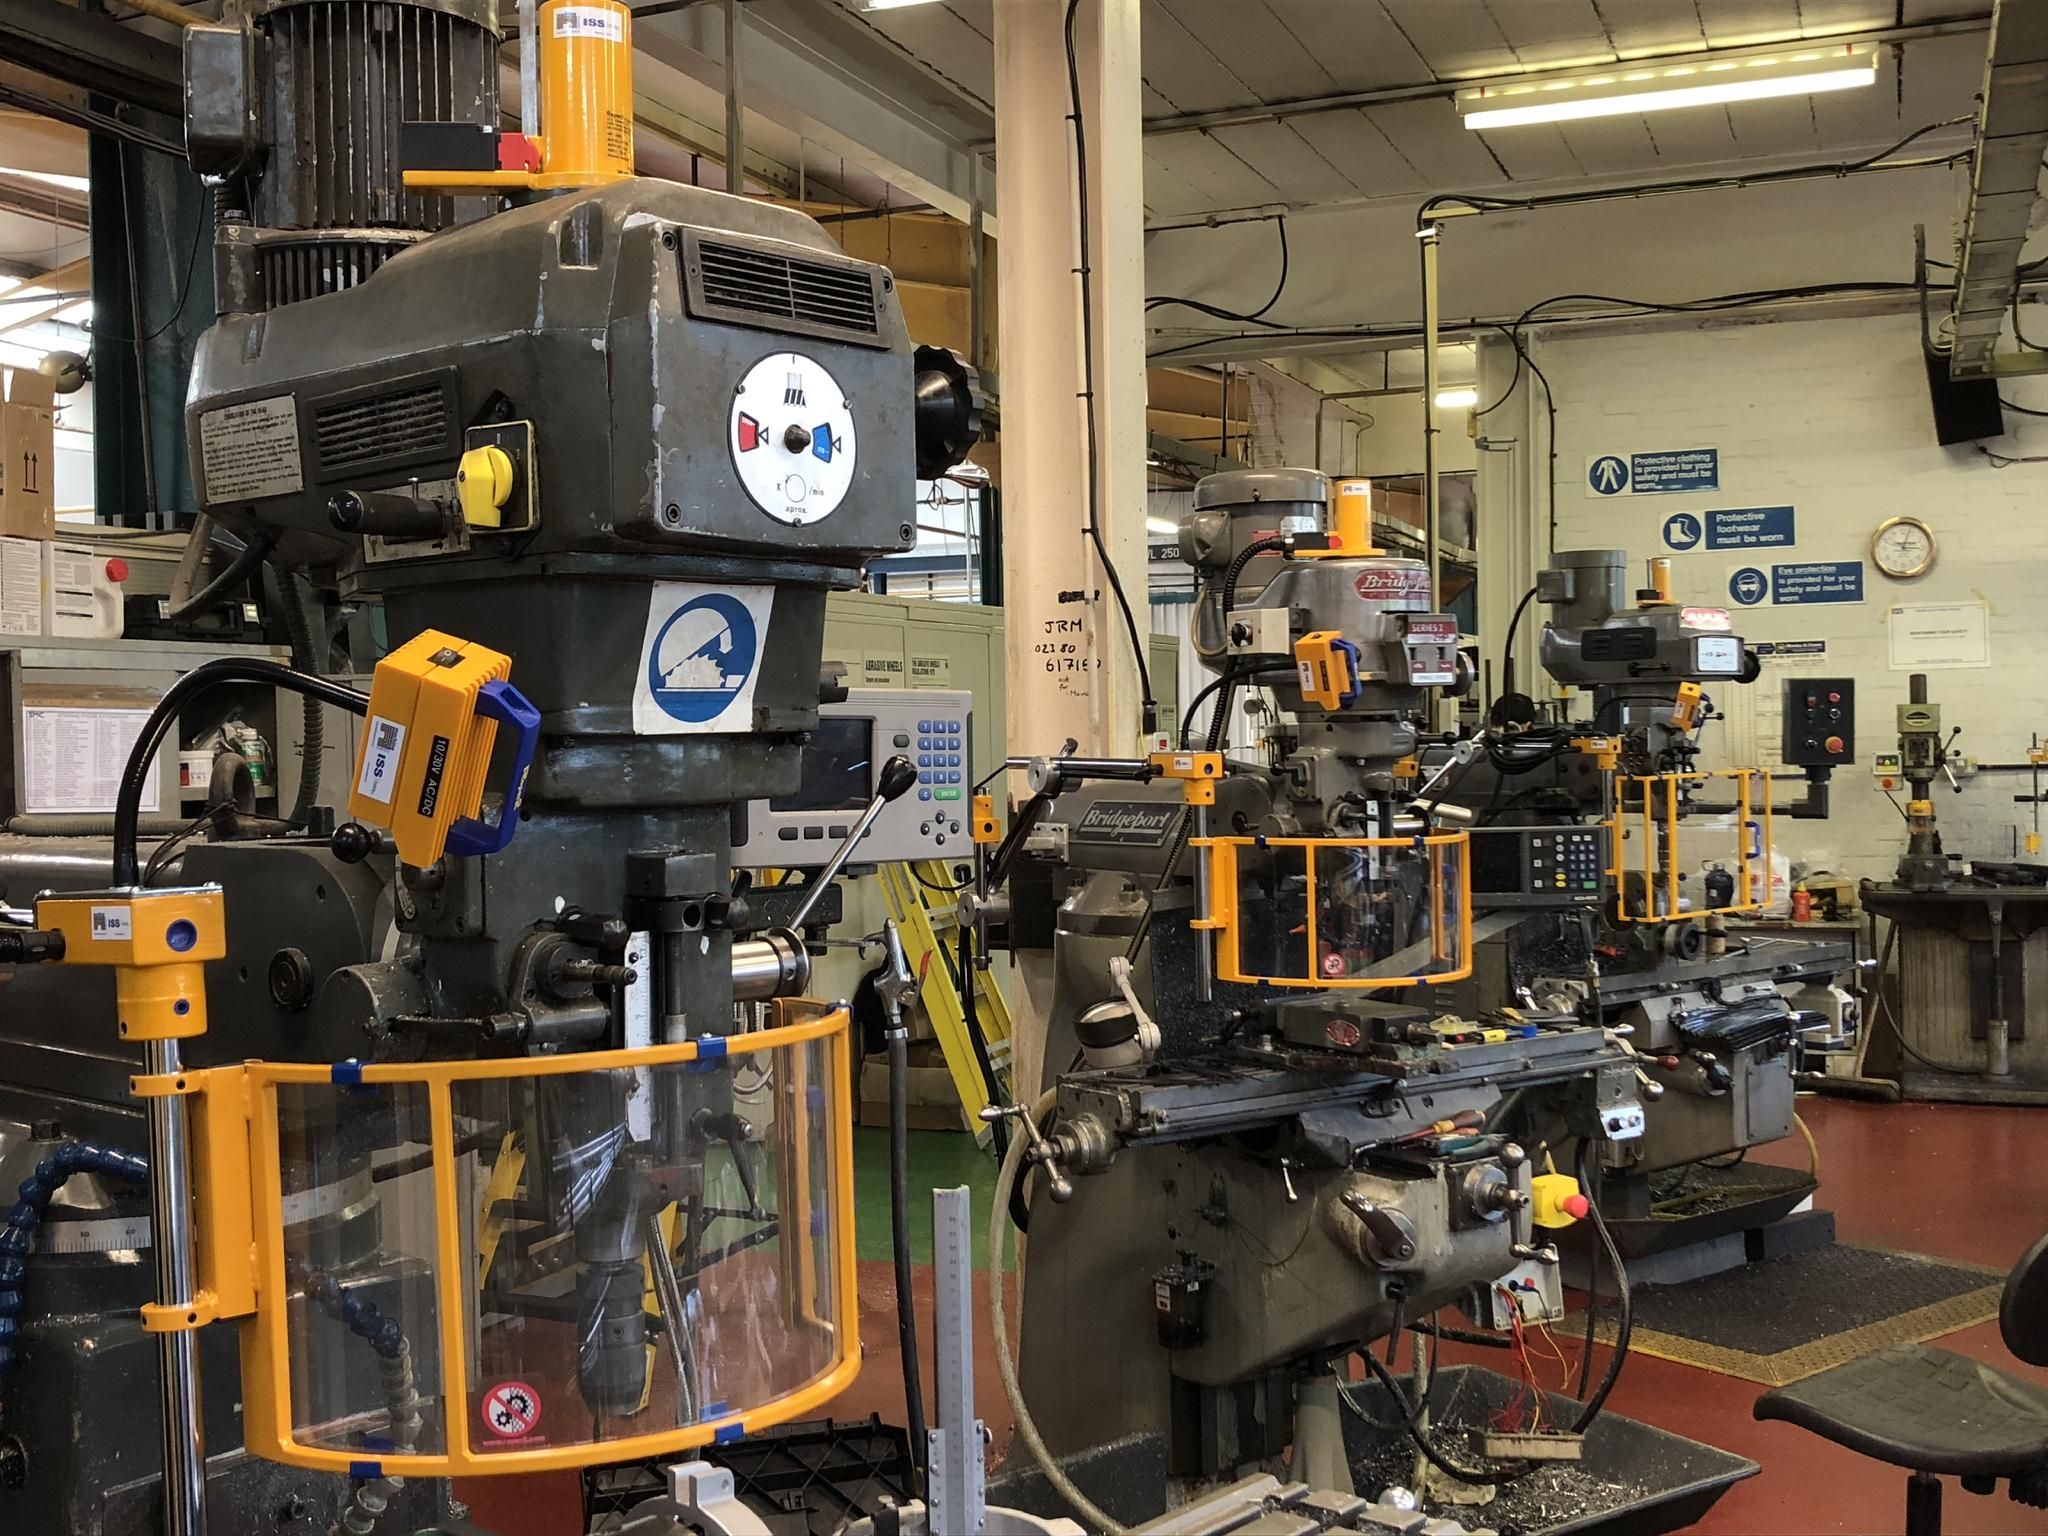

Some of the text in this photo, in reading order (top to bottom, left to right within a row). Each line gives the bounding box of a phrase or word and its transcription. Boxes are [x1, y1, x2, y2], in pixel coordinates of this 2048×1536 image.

[583, 18, 605, 28] ISS
[1634, 454, 1710, 465] Protective clothing
[1644, 463, 1680, 474] provided
[1681, 462, 1693, 470] for
[1694, 462, 1714, 471] your
[1634, 473, 1659, 482] safety
[1716, 512, 1765, 522] Protective
[1716, 524, 1760, 533] footwear
[1716, 534, 1784, 544] must be worn
[1161, 547, 1180, 559] 250
[1778, 565, 1837, 576] Eye protection
[1787, 575, 1821, 585] provided
[1838, 575, 1856, 583] your
[1779, 586, 1804, 594] safety
[1805, 584, 1820, 592] and
[1045, 618, 1082, 634] JRM
[1411, 624, 1437, 633] SERIES
[1034, 643, 1076, 654] 023 80
[865, 659, 903, 672] ABRASIVE WHEELS
[373, 753, 386, 778] ISS
[421, 739, 447, 816] 10/30V AC/DC
[1083, 809, 1171, 837] Bridgeport
[108, 919, 120, 928] ISS
